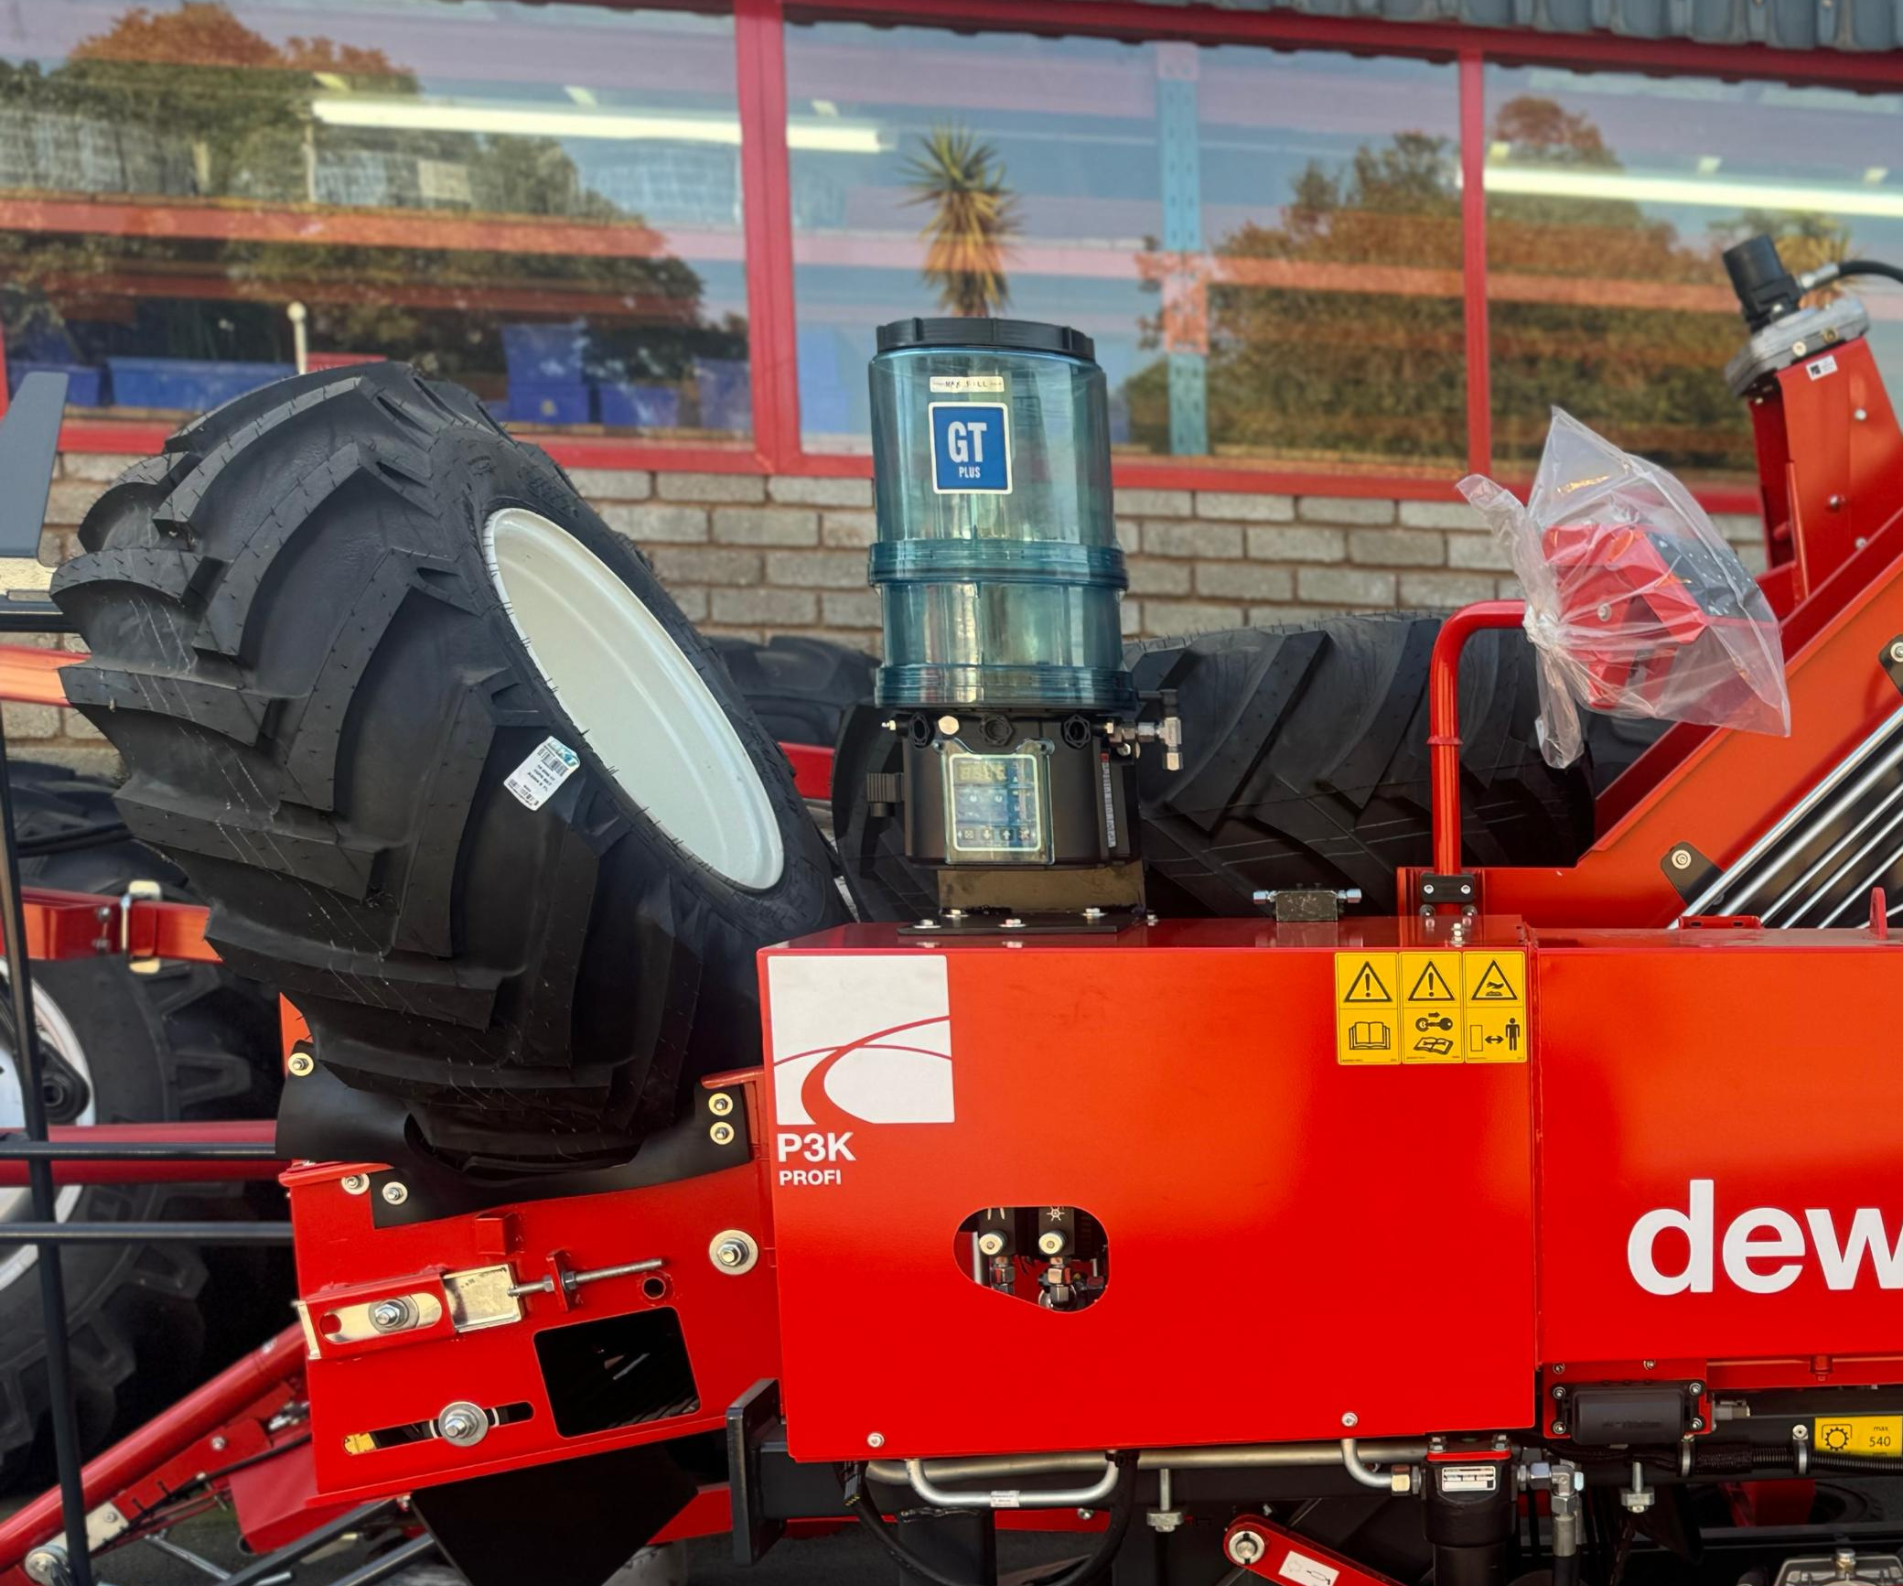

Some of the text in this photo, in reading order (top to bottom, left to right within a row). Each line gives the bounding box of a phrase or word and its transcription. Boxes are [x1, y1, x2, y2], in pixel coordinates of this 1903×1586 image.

[947, 421, 987, 463] GT
[958, 466, 982, 479] PLUS
[777, 1131, 857, 1163] P3K
[779, 1169, 842, 1186] PROFI
[1868, 1436, 1892, 1447] 540
